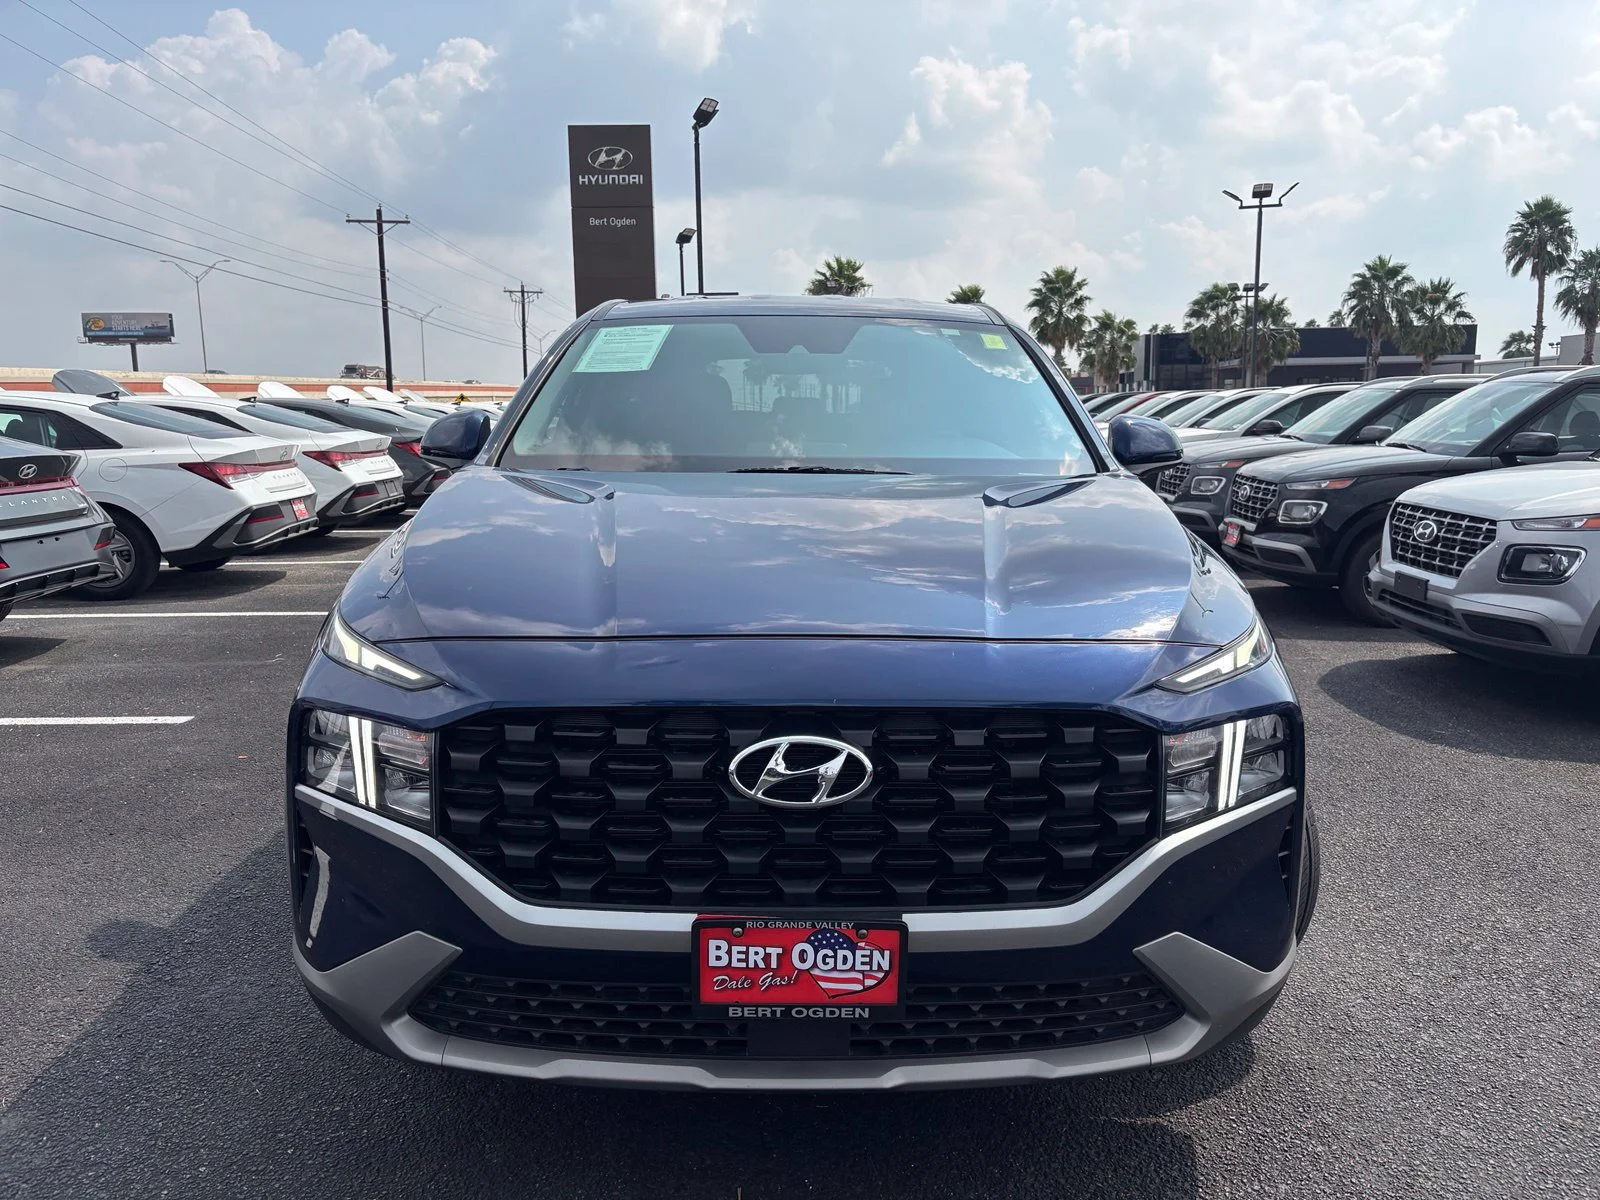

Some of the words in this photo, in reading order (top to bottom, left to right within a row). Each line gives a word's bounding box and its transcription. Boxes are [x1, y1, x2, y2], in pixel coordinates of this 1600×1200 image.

[578, 174, 644, 186] HYUNDAI
[589, 217, 607, 226] Bert
[609, 217, 636, 227] Ogden
[0, 495, 67, 507] LANTRA
[746, 921, 766, 929] RIO
[768, 921, 812, 929] GRANDE
[815, 922, 855, 930] VALLEY
[708, 939, 783, 969] BERT
[791, 942, 890, 971] OGDEN
[712, 975, 752, 991] Dale
[758, 970, 798, 992] Gas!
[728, 1007, 785, 1018] BERT
[791, 1007, 869, 1019] OGDEN
